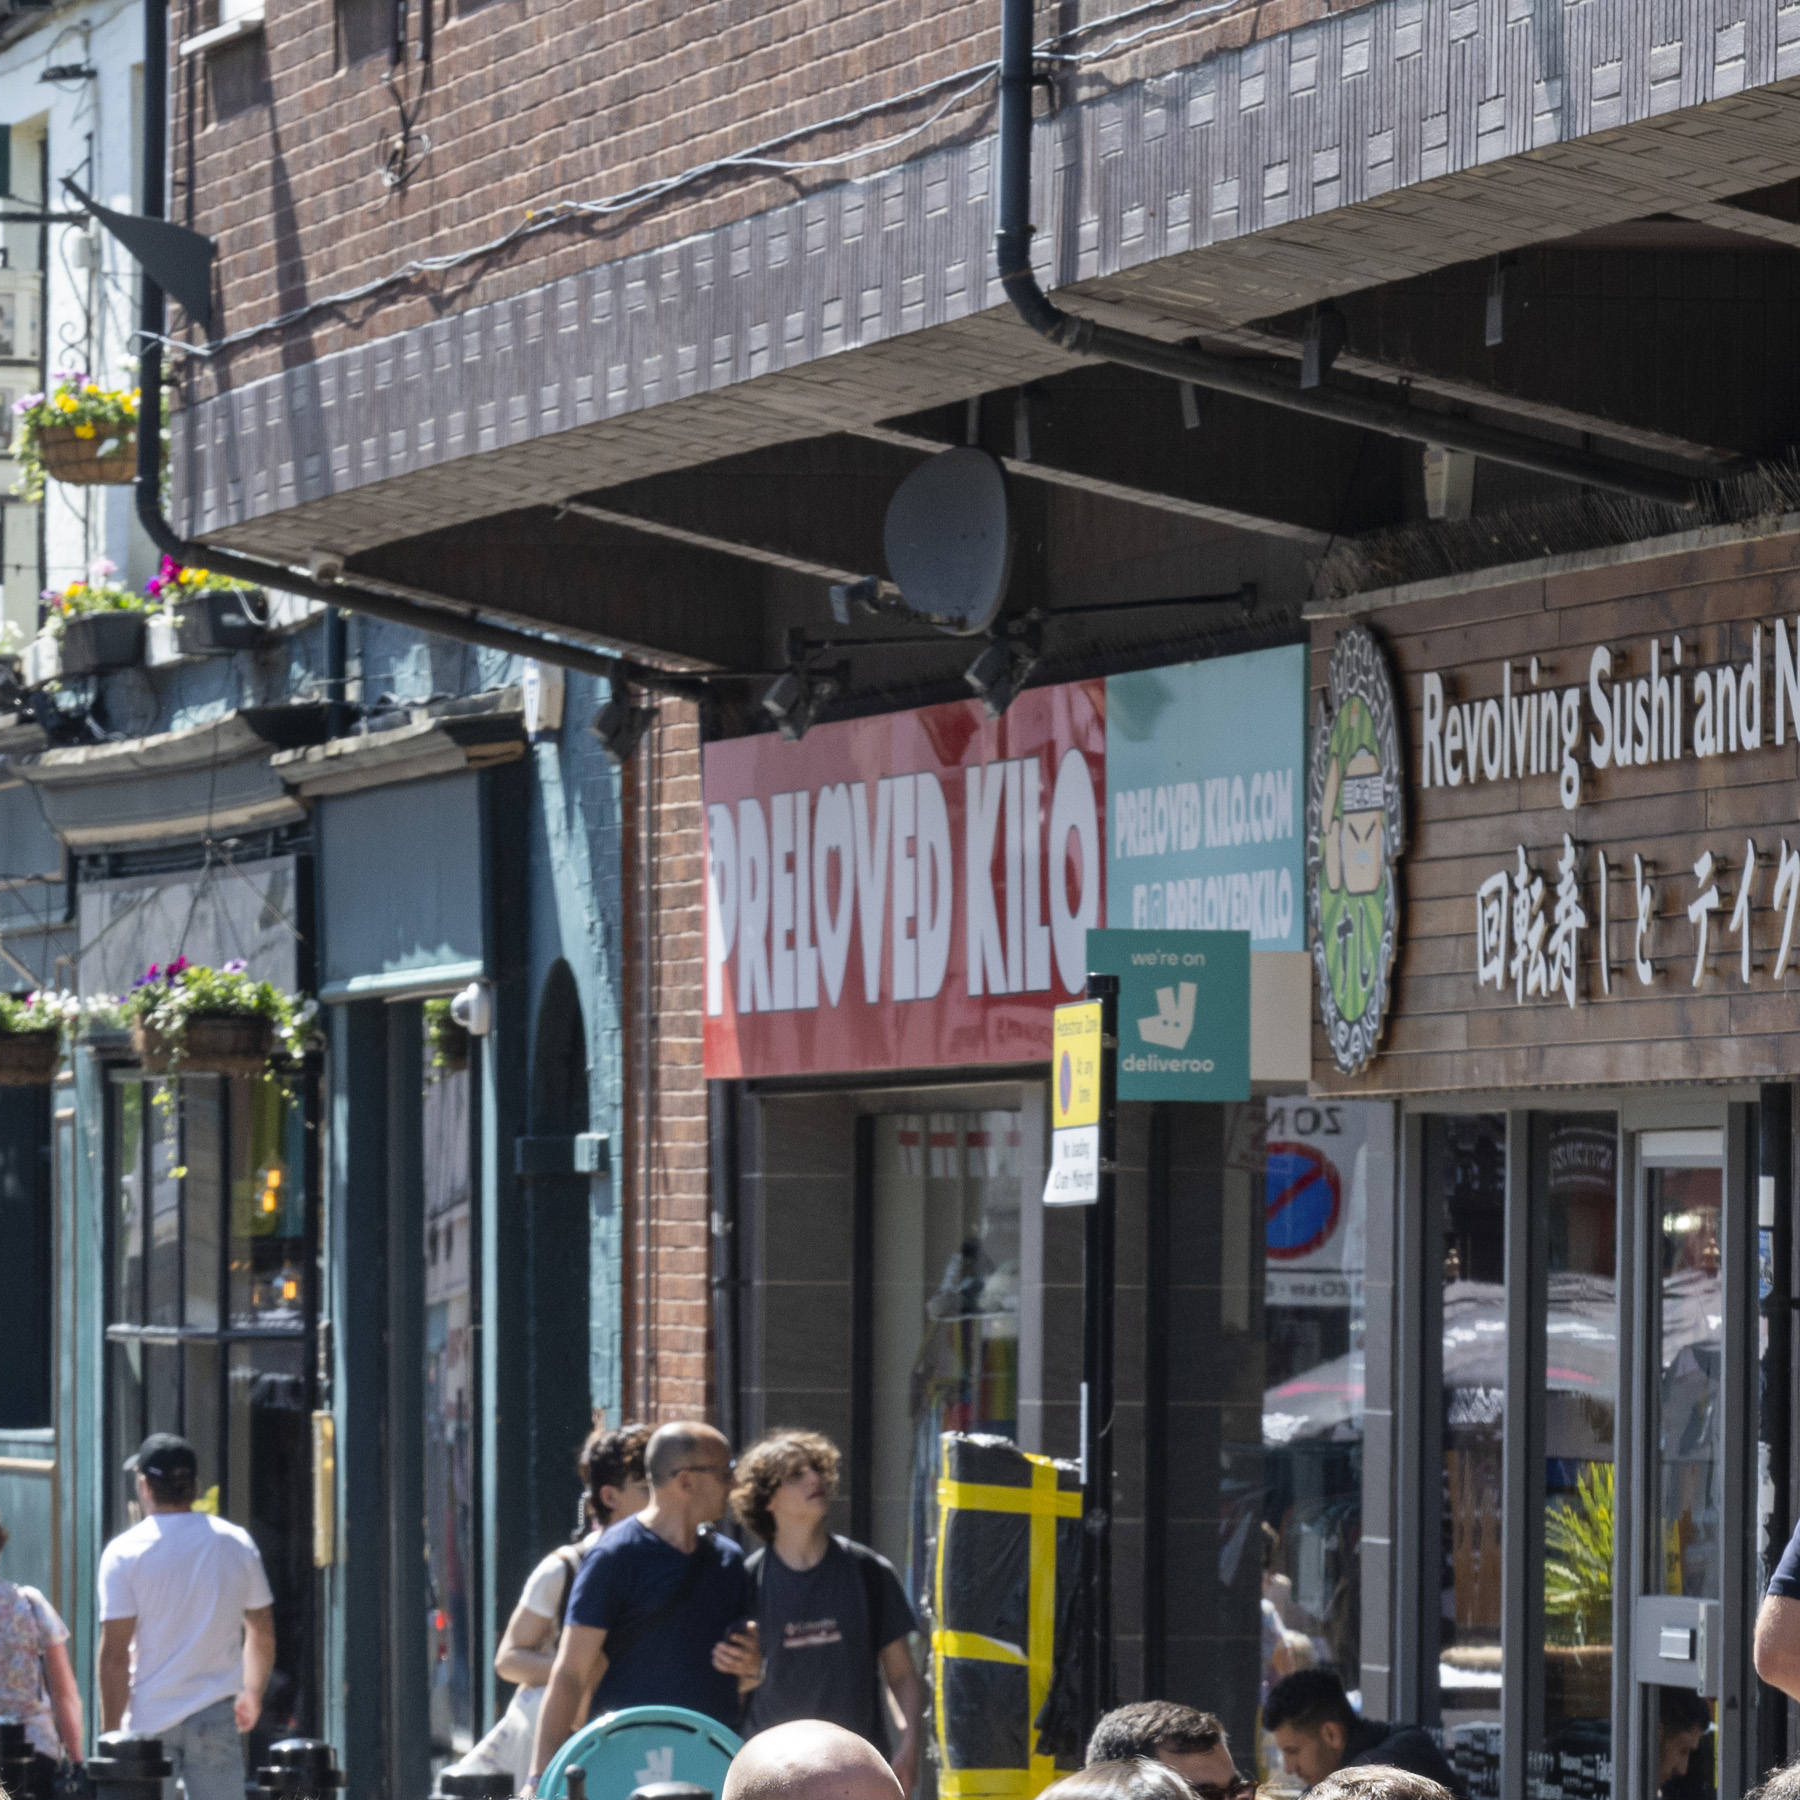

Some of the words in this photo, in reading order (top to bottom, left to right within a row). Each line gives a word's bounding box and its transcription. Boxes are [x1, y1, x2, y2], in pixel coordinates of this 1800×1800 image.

[1422, 656, 1581, 810] Revolving
[1590, 634, 1682, 769] Sushi
[1693, 622, 1762, 758] and
[1115, 782, 1199, 860] PRELOVED
[1204, 768, 1294, 849] KILO.COM
[706, 770, 953, 1019] PRELOVED
[964, 747, 1098, 998] KILO
[1182, 953, 1207, 967] on
[1121, 1053, 1216, 1073] deliveroo
